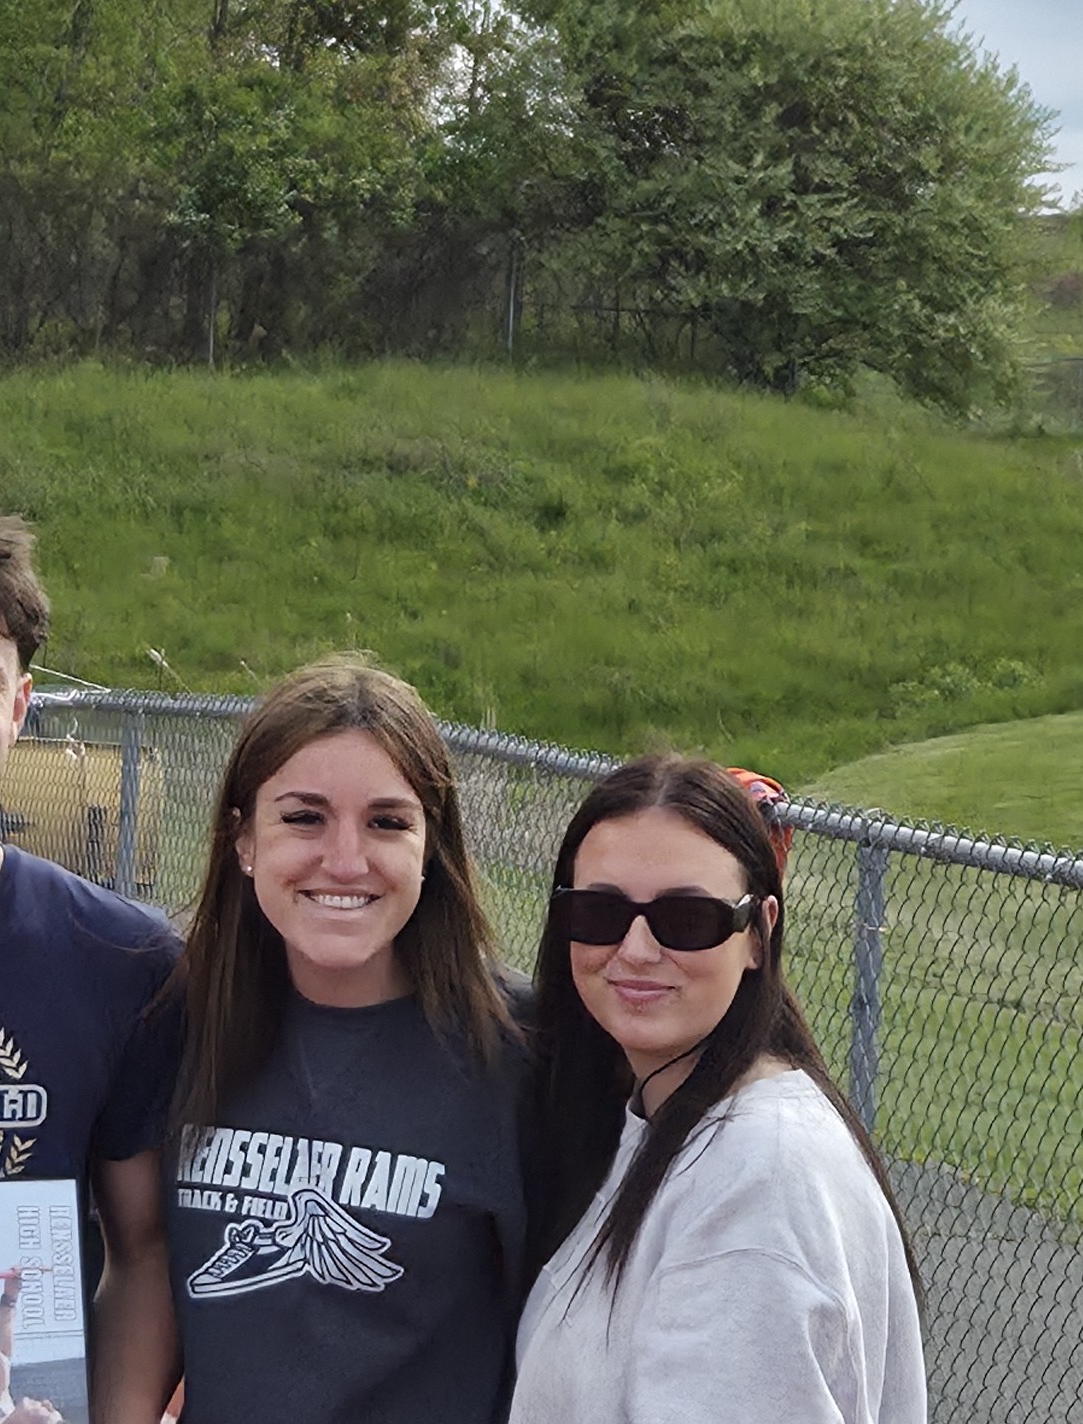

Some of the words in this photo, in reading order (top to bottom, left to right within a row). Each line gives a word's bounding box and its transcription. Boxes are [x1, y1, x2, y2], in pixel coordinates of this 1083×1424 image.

[177, 1188, 222, 1212] TRACK
[225, 1193, 238, 1213] &
[241, 1195, 289, 1220] FIELD
[340, 1147, 446, 1219] RAMS
